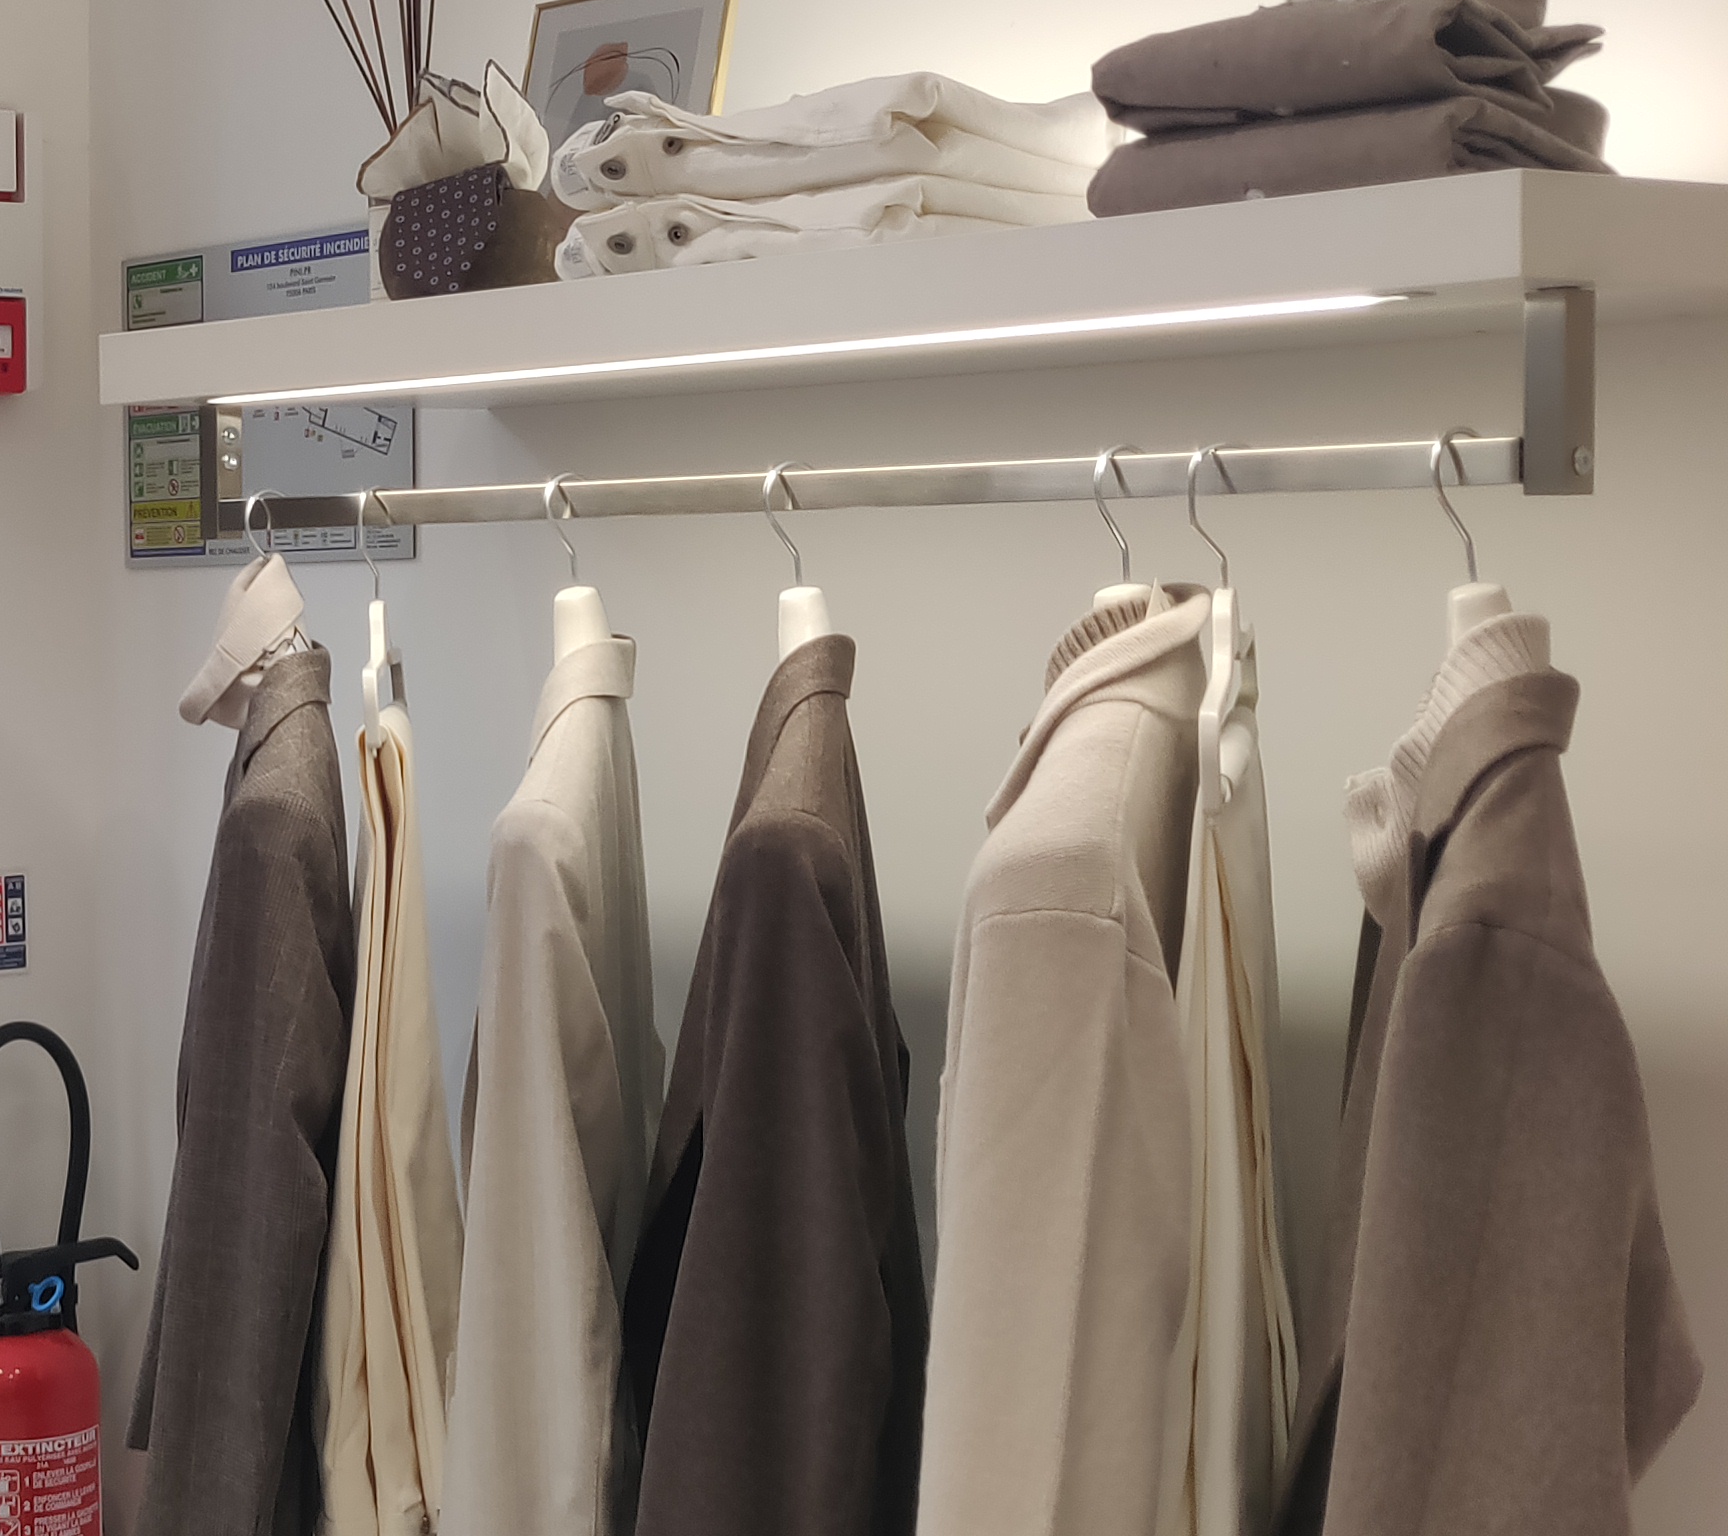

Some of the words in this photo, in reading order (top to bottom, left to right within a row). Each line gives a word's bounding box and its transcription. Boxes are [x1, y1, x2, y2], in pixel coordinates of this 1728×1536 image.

[237, 253, 262, 268] PLAN
[264, 250, 276, 264] DE
[278, 241, 321, 262] SÉCURITÉ
[323, 236, 369, 255] INCENDIE
[131, 269, 167, 284] ACCIDENT
[1, 1429, 96, 1456] EXTINCTEUR
[24, 1476, 30, 1487] 1
[23, 1500, 31, 1512] 2
[24, 1525, 31, 1536] 3
